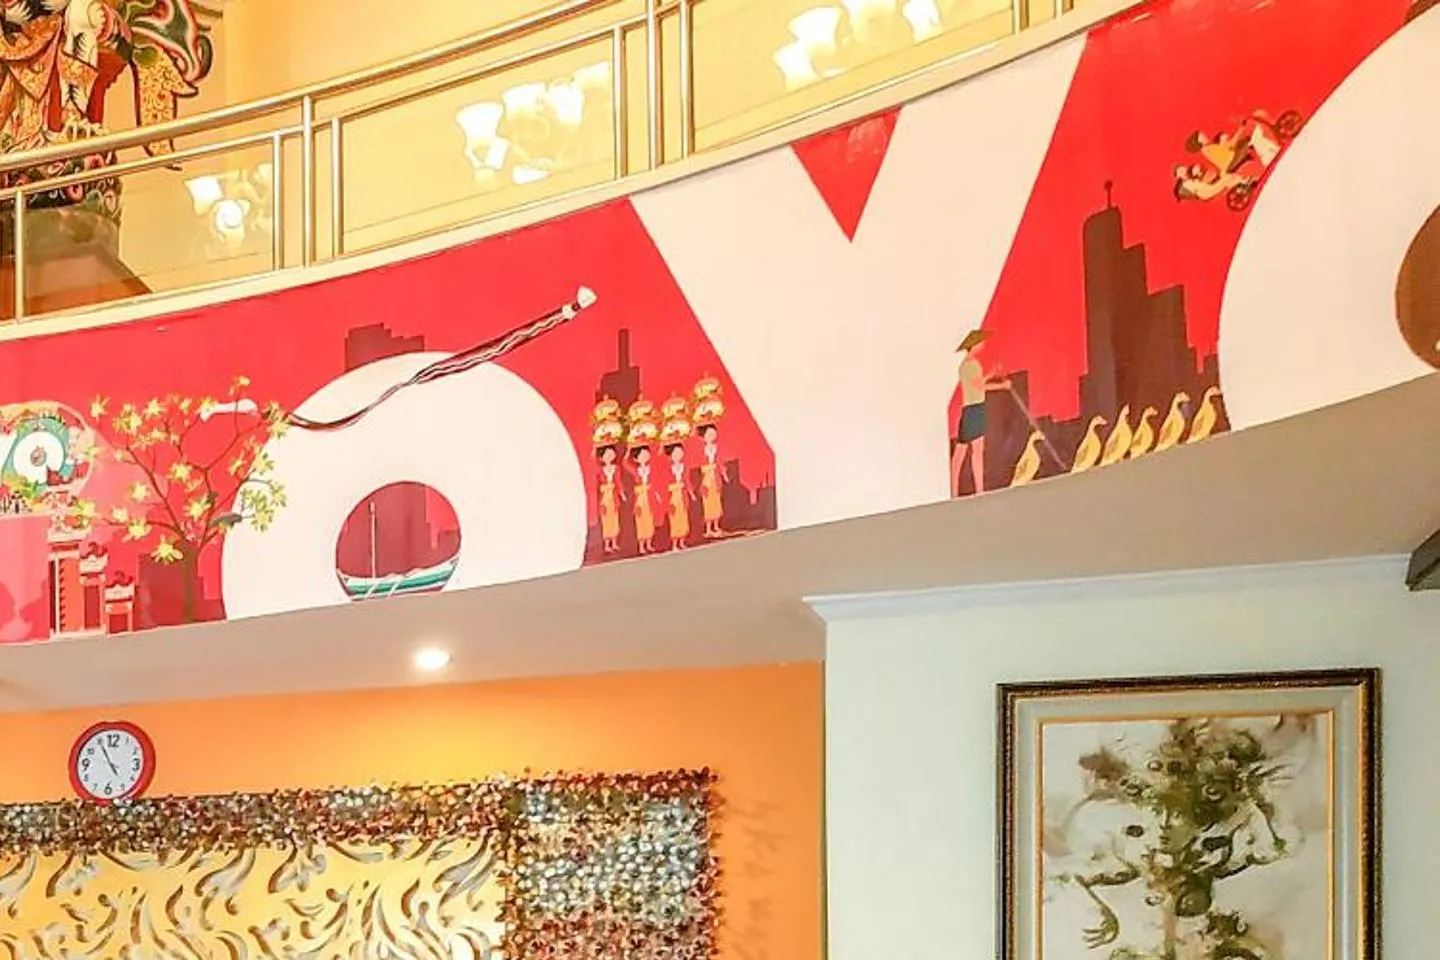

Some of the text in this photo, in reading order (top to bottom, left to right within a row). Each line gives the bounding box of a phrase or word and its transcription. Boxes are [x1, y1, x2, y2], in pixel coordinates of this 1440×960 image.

[107, 734, 120, 748] 12
[82, 758, 90, 771] 9
[131, 758, 140, 771] 3
[103, 781, 112, 795] 6
